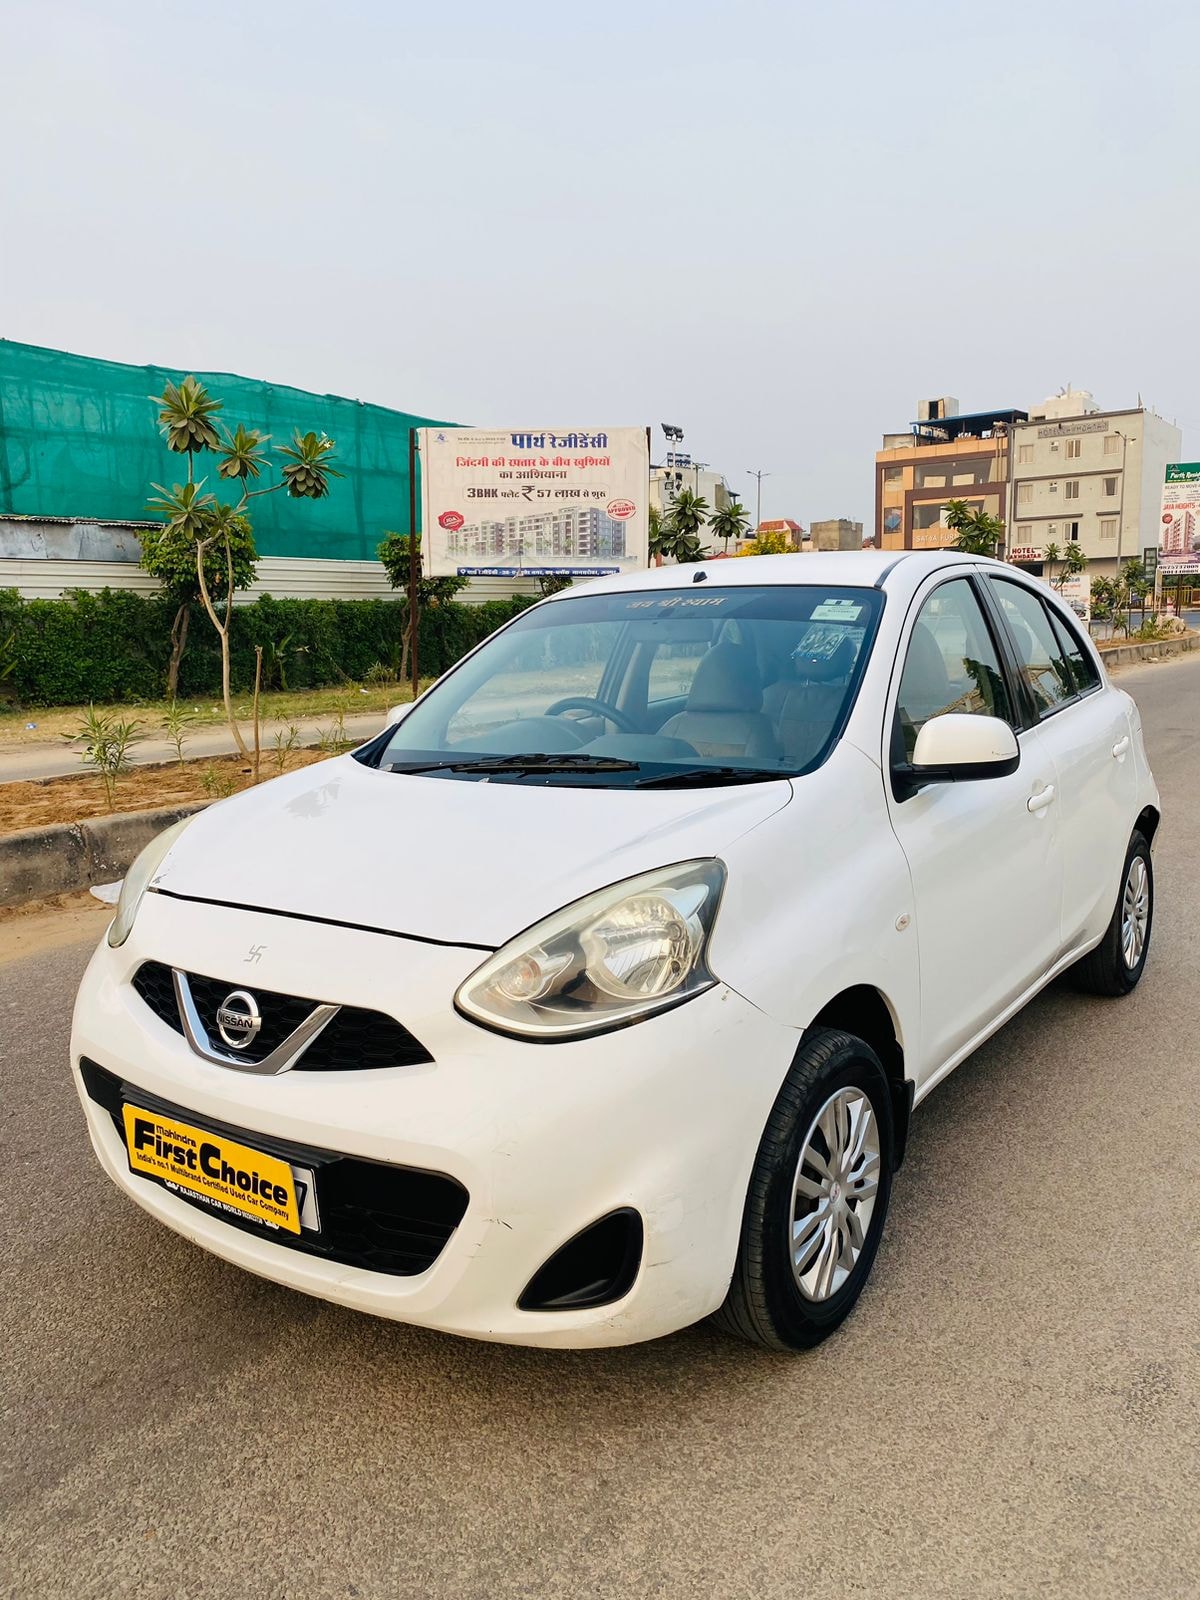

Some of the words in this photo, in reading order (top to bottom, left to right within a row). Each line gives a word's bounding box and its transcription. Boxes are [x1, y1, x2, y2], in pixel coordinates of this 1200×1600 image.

[511, 433, 545, 448] पार्थ
[547, 432, 608, 448] रेजीडेंसी
[456, 456, 488, 467] जिंदगी
[491, 456, 505, 467] की
[539, 456, 549, 467] के
[552, 456, 570, 467] बीच
[573, 456, 611, 469] खुशियों
[499, 470, 513, 479] का
[516, 469, 567, 479] आशियाना
[467, 488, 498, 498] 3BHK
[554, 489, 581, 498] लाख
[583, 489, 589, 498] से
[219, 1012, 253, 1029] NISSAN
[134, 1117, 197, 1170] First
[199, 1142, 288, 1207] Choice
[136, 1152, 156, 1165] India's
[170, 1163, 202, 1183] Multibrand
[202, 1176, 229, 1194] Certified
[229, 1186, 246, 1201] Used
[246, 1194, 258, 1207] Car
[259, 1199, 289, 1222] Company
[210, 1197, 222, 1209] CAR
[222, 1202, 242, 1216] WORLD
